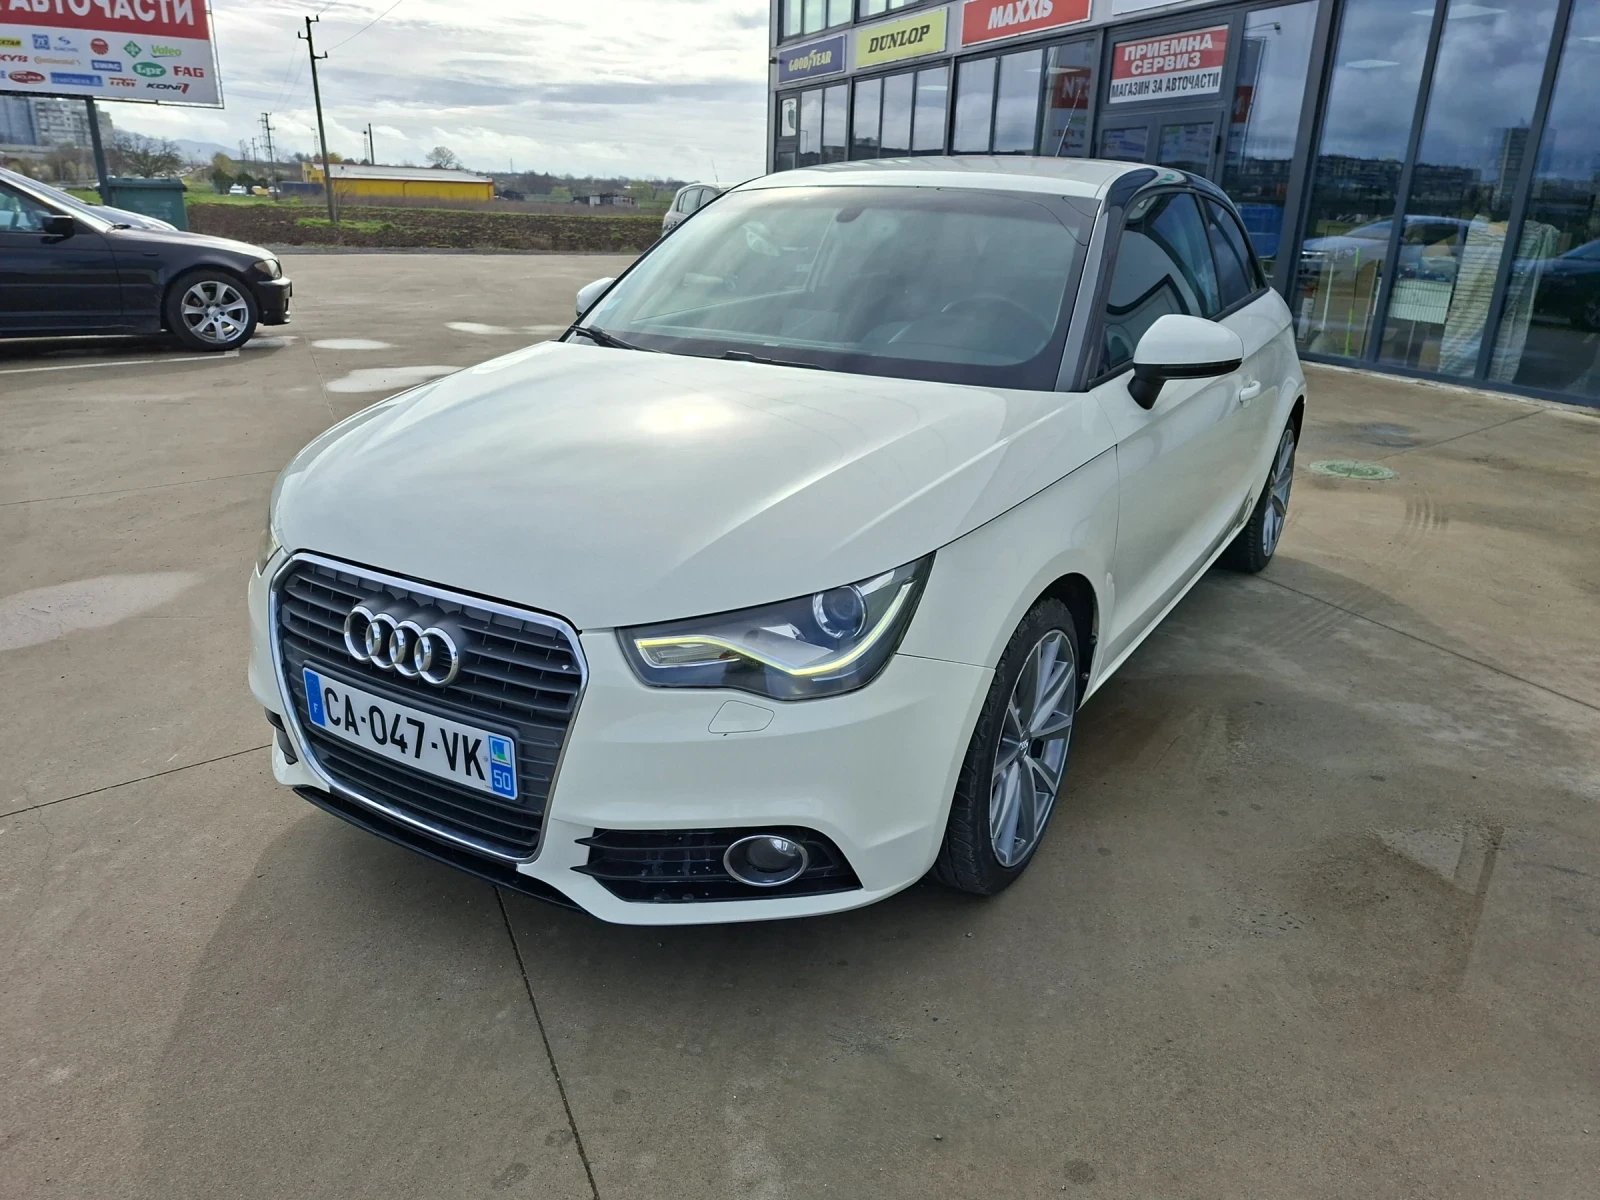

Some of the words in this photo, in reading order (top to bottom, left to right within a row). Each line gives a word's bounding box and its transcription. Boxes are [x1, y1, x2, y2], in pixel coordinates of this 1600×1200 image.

[987, 0, 1054, 30] MAXXIS
[868, 24, 931, 54] DUNLOP
[1124, 33, 1213, 61] ПРИЕМНА
[173, 66, 204, 78] FAG
[1130, 51, 1201, 75] СЕРВИЗ
[1110, 80, 1149, 98] МАГАЗИН
[1152, 79, 1163, 94] ЗА
[1165, 72, 1220, 92] АВТОЧАСТИ
[324, 687, 486, 781] CA-047-VK
[493, 769, 511, 791] 50
